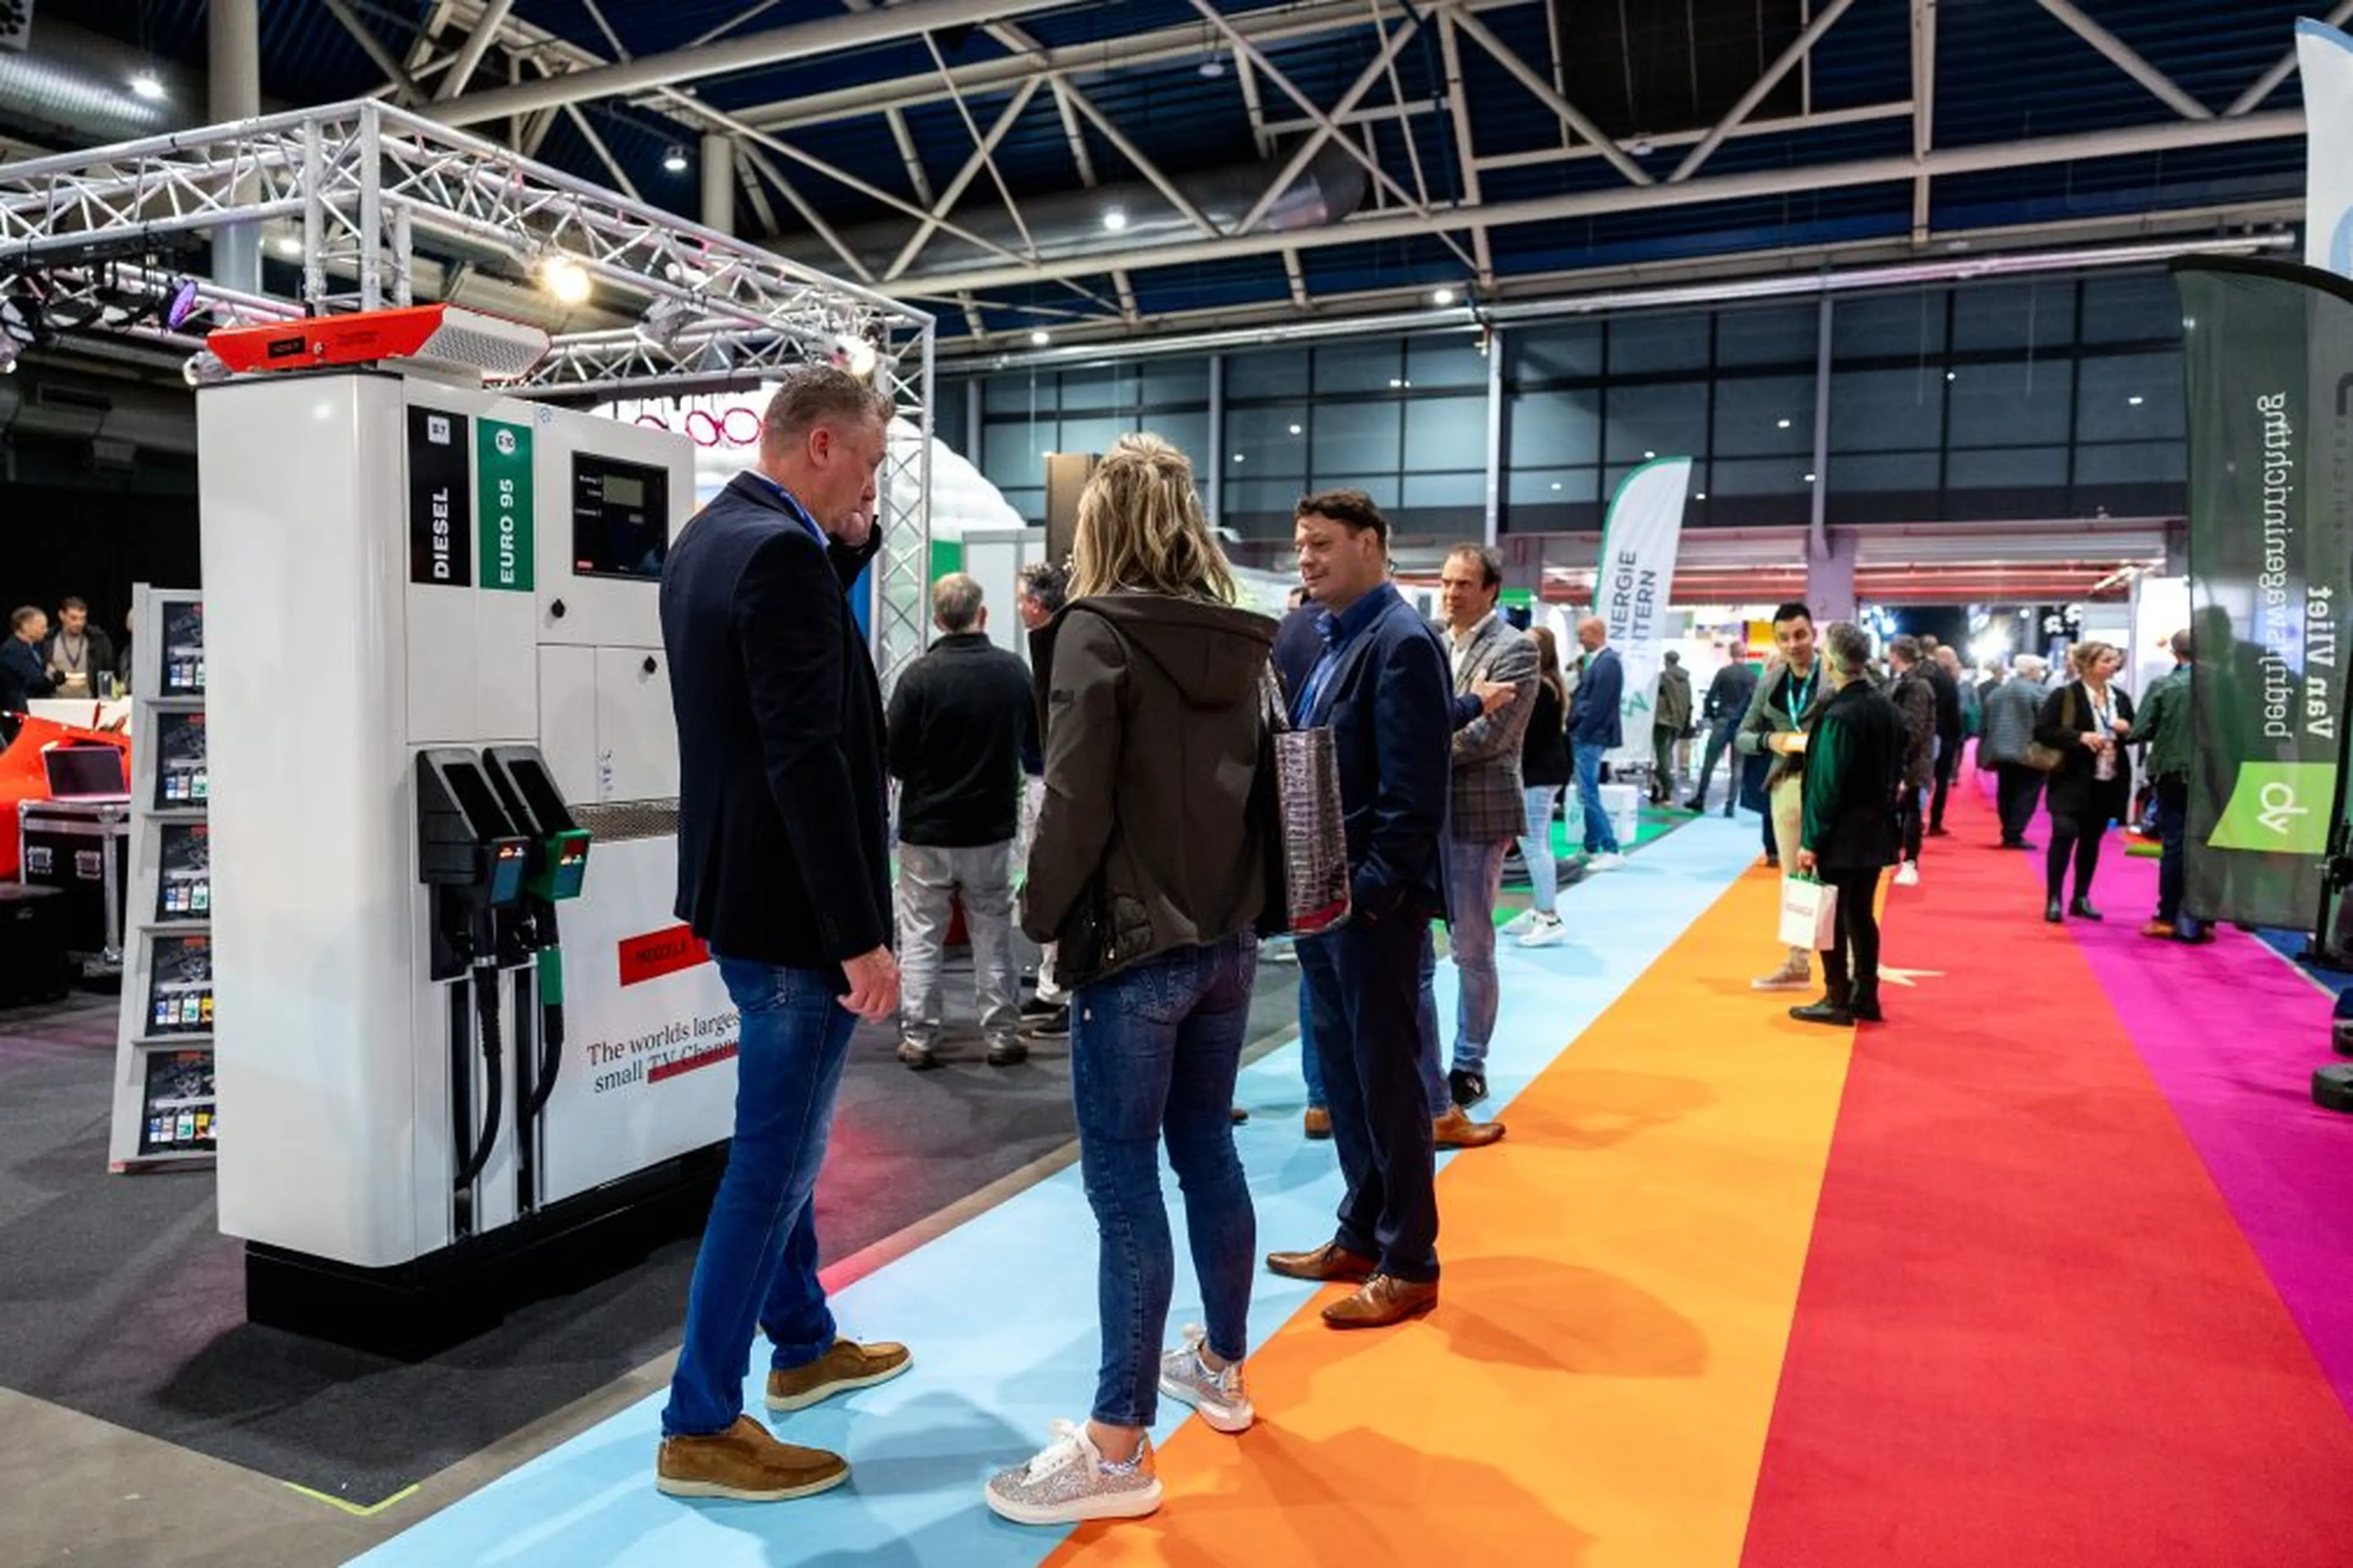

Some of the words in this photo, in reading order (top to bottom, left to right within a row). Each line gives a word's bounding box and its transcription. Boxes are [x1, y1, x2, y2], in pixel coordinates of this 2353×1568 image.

[499, 478, 514, 508] 95
[432, 487, 450, 579] DIESEL
[499, 515, 515, 584] EURO
[1609, 549, 1637, 640] NERGIE
[586, 1041, 625, 1067] The
[629, 1021, 691, 1055] worlds
[594, 1059, 643, 1094] small
[647, 1050, 677, 1070] TV
